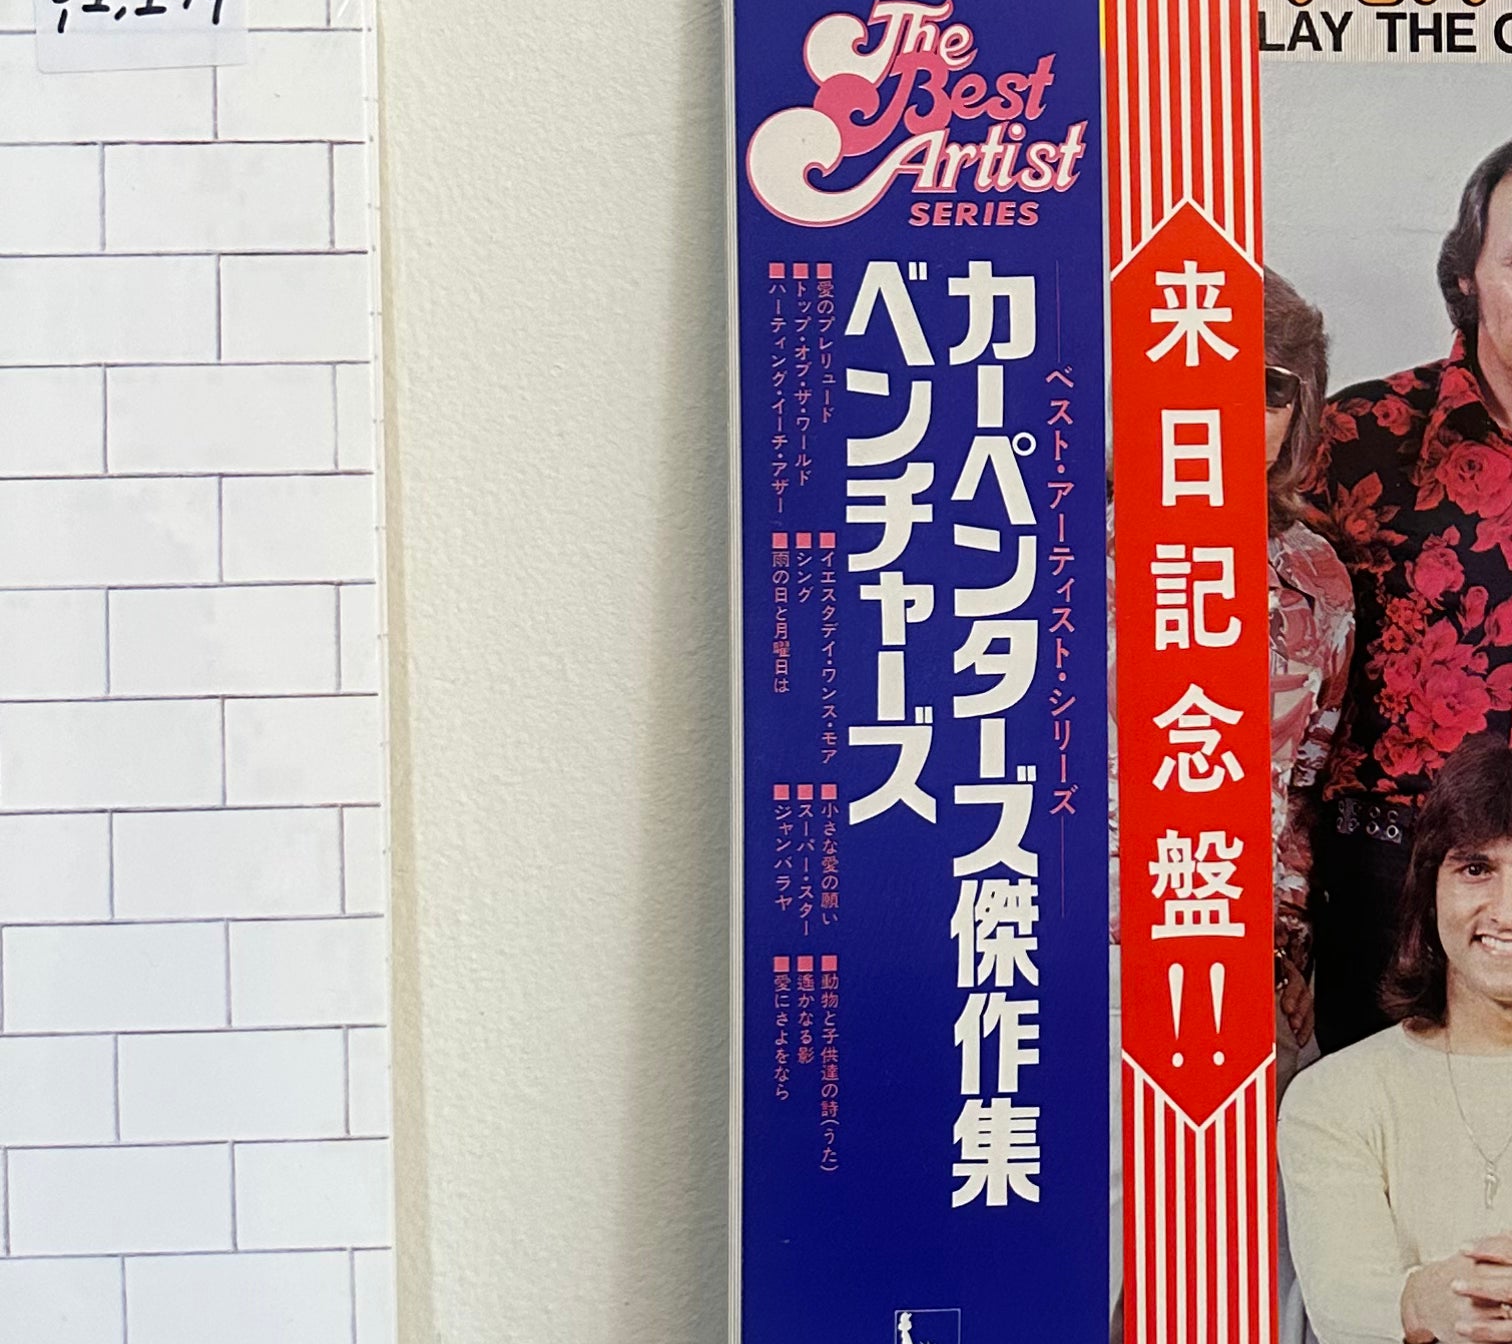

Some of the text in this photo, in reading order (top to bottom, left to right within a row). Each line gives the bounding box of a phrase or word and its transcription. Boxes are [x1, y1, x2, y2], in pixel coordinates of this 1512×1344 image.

[1258, 11, 1353, 52] LAY
[1376, 12, 1477, 53] THE
[814, 54, 1056, 157] Best
[746, 118, 1089, 227] Artist
[908, 201, 1040, 226] SERIES
[816, 281, 836, 424] 愛のプレリュード
[796, 552, 814, 603] シング
[844, 261, 937, 825] ベンチャーズ
[772, 551, 790, 693] 雨の日と月曜日は
[948, 260, 1042, 1208] カーペンターズ傑作集
[821, 802, 839, 925] 小さな愛の願い
